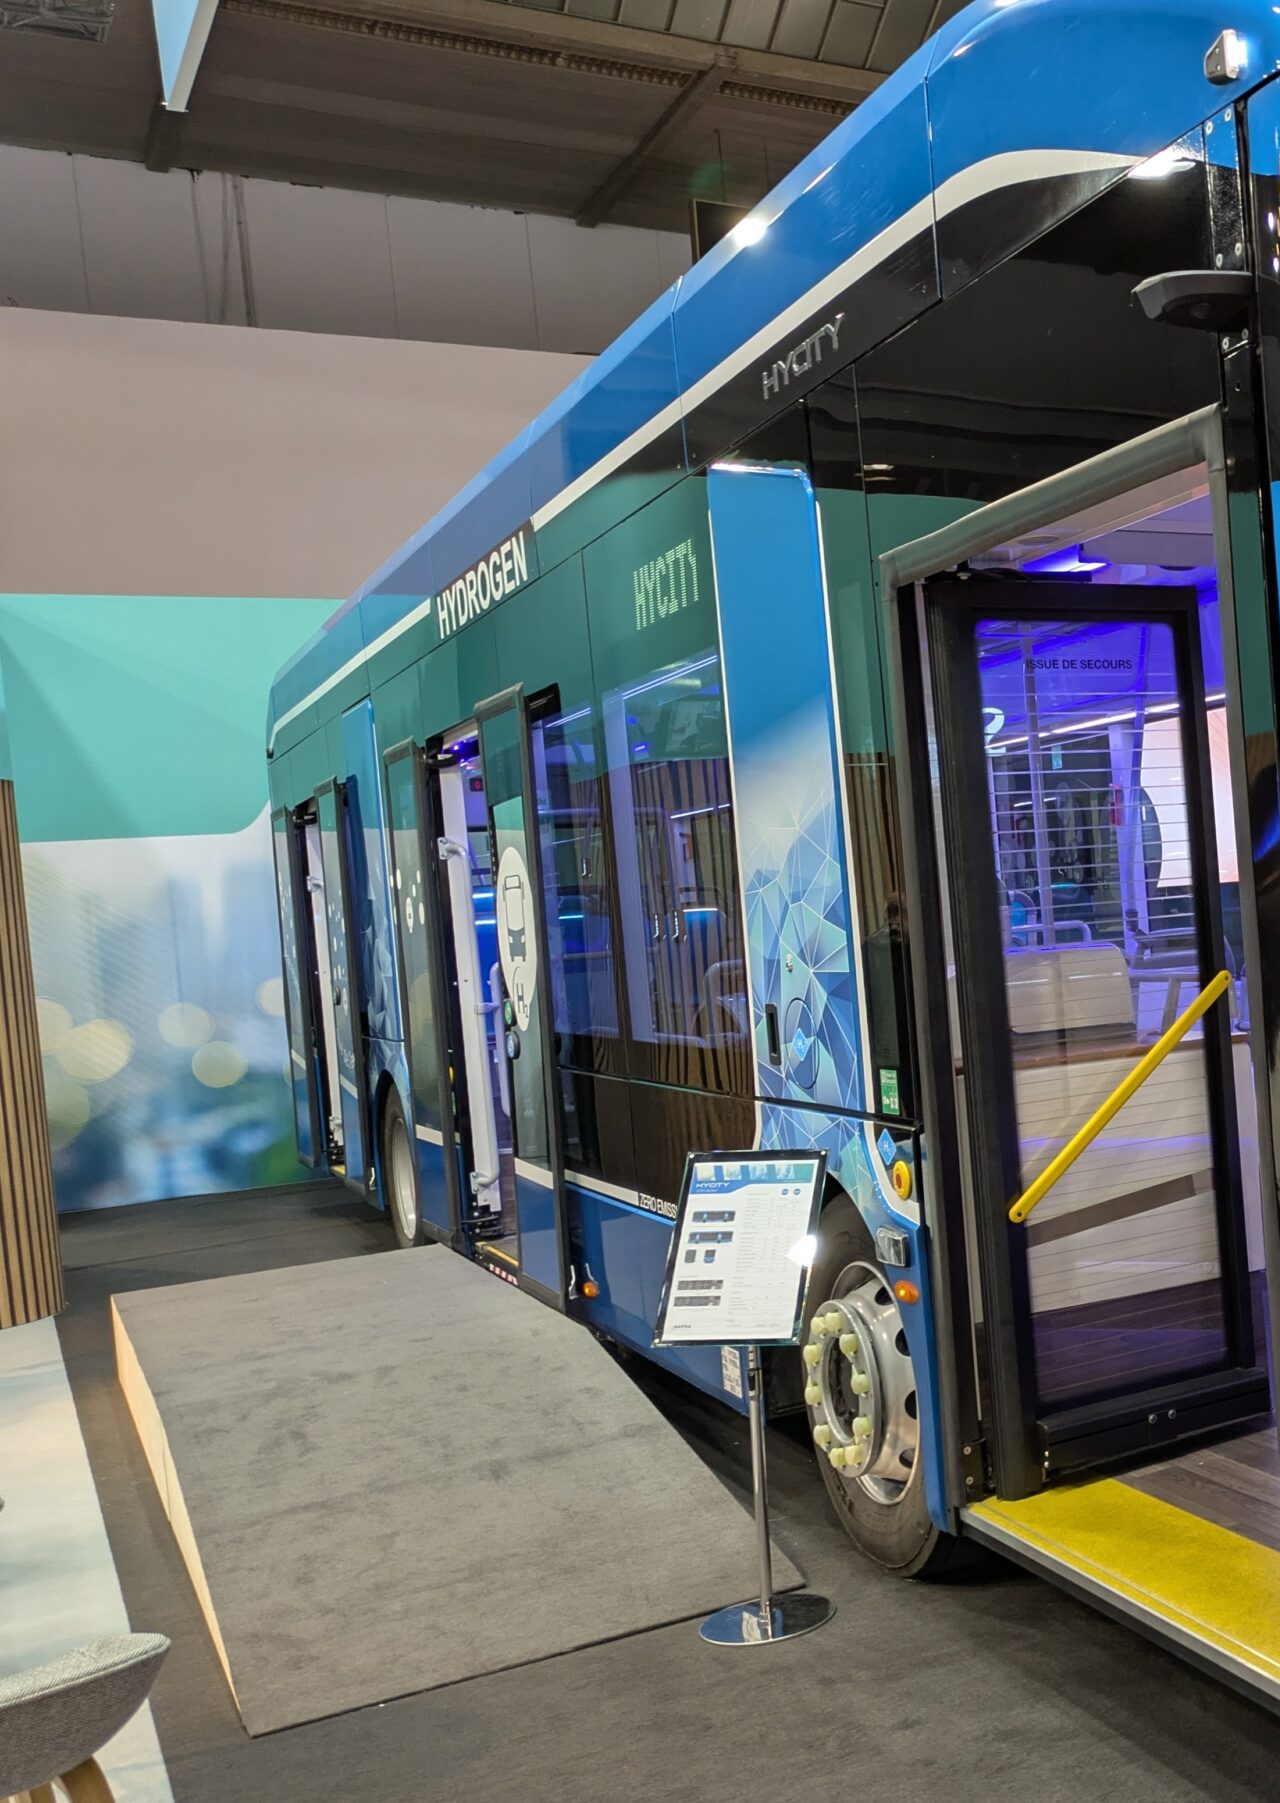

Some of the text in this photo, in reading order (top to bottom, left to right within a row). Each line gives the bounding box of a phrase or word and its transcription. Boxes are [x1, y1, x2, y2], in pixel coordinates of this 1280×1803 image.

[762, 312, 845, 400] HYCITY
[436, 528, 528, 639] HYDROGEN
[633, 539, 699, 630] HYCITY
[1026, 659, 1132, 670] ISSUE DE SECOURS
[639, 1193, 657, 1212] ZERO
